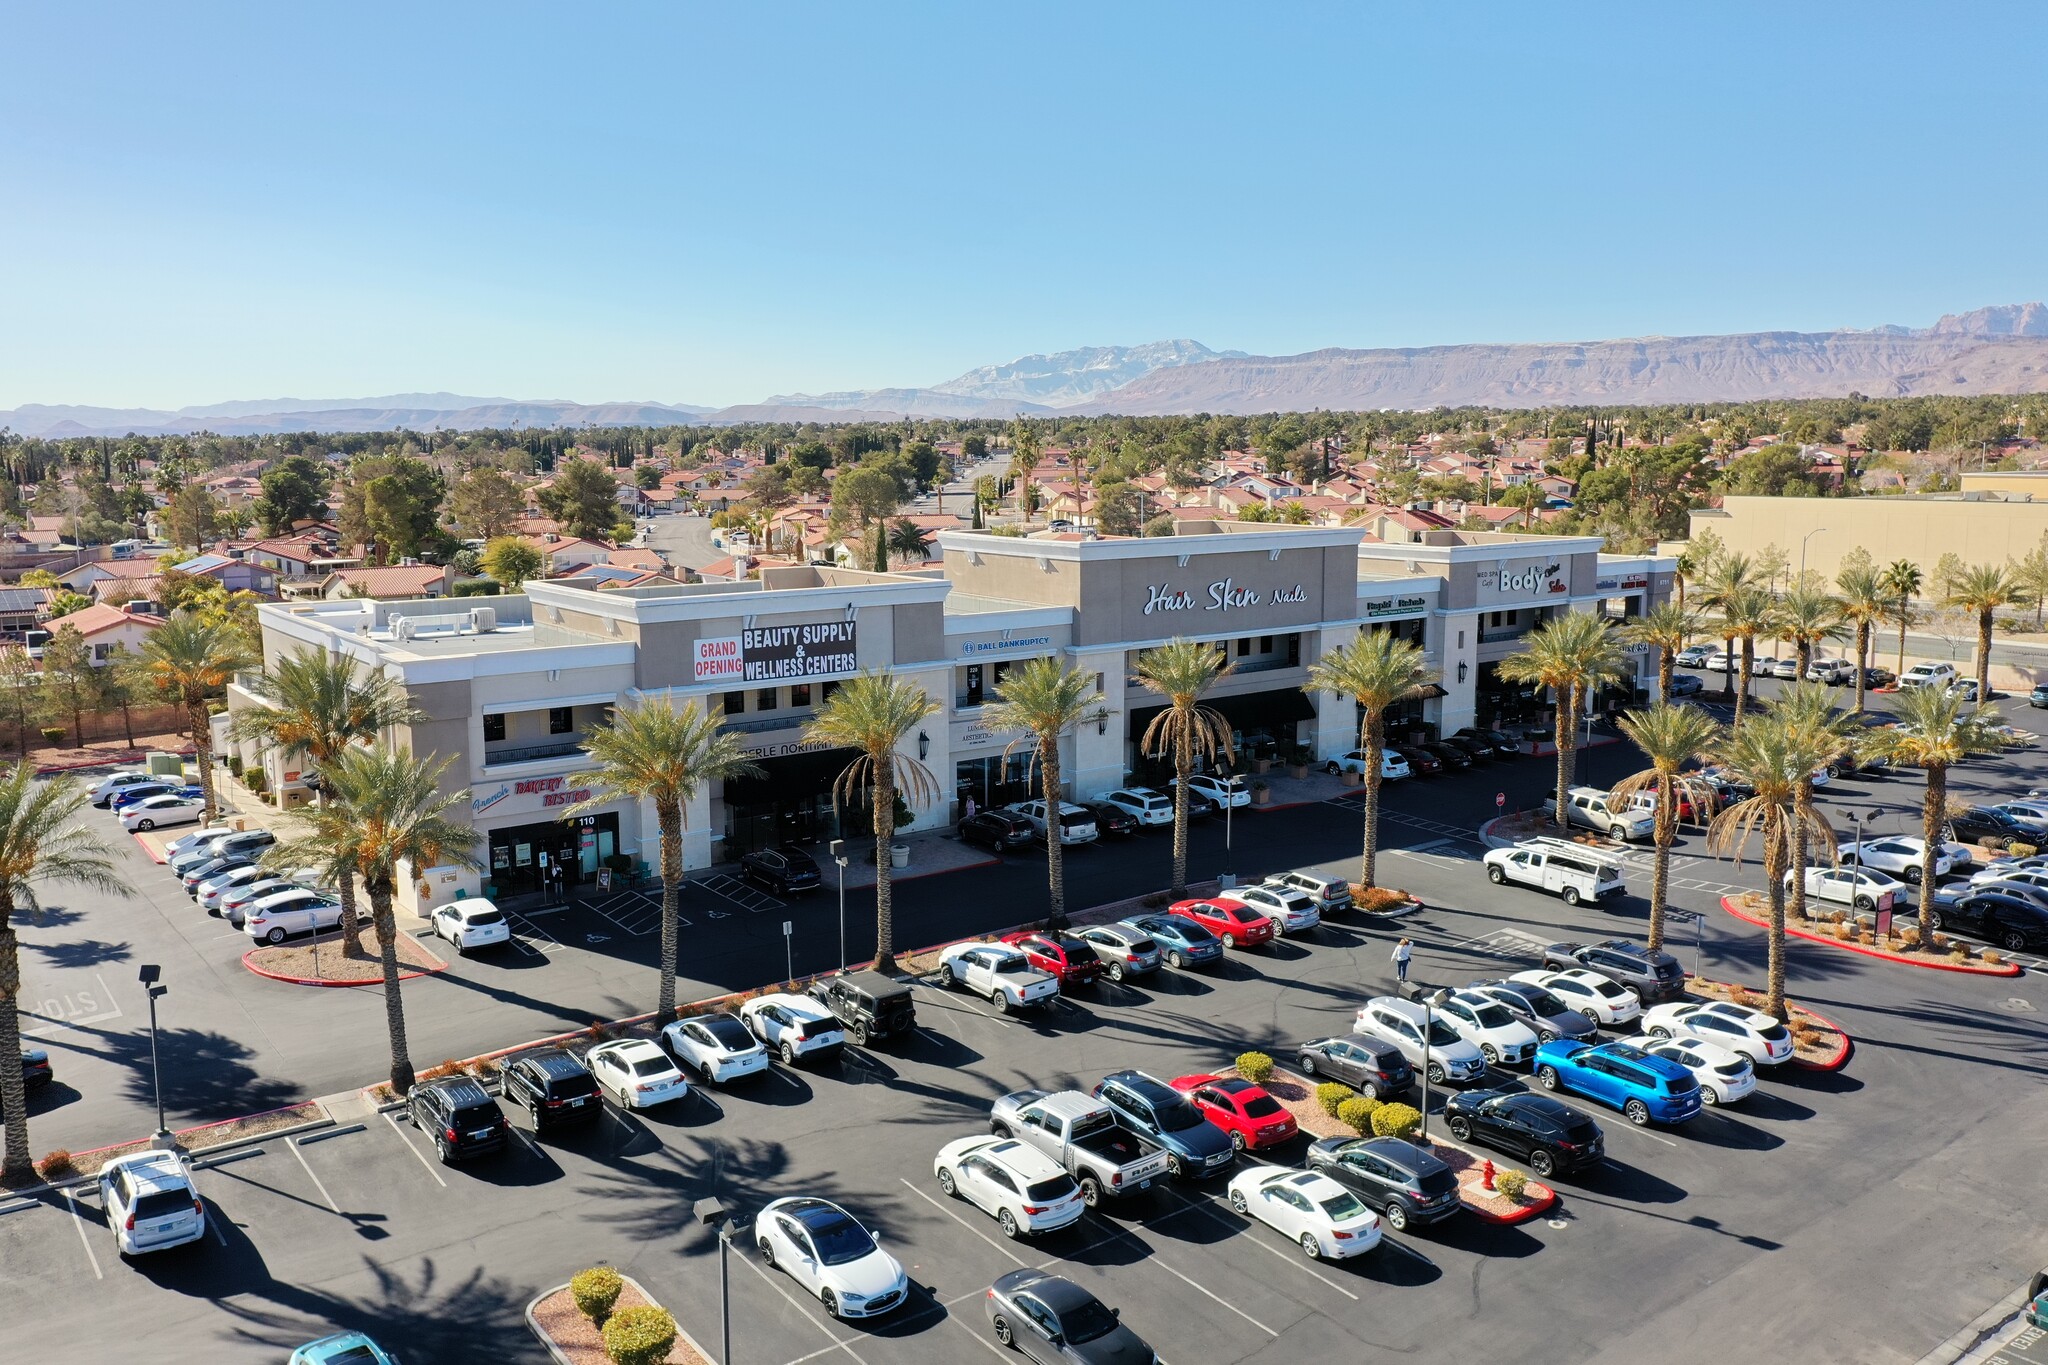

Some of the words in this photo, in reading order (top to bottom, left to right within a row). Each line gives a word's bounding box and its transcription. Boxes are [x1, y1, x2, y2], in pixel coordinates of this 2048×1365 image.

[1499, 567, 1545, 594] Body
[1144, 583, 1196, 615] Hair
[1205, 577, 1260, 612] Skin
[1269, 584, 1308, 606] Nails
[1398, 597, 1425, 607] Rehab
[744, 627, 799, 649] BEAUTY
[803, 623, 854, 644] SUPPLY
[978, 642, 997, 651] BALL
[998, 637, 1049, 649] BANKRUPTCY
[701, 640, 736, 658] GRAND
[795, 645, 806, 658] &
[696, 658, 742, 676] OPENING
[745, 658, 803, 680] WELLNESS
[806, 652, 855, 675] CENTERS
[472, 784, 509, 811] French
[515, 777, 563, 795] BAKERY
[543, 789, 591, 807] BISTRO
[579, 817, 595, 826] 110
[31, 991, 98, 1020] STOP
[1132, 1162, 1159, 1176] RAM
[2010, 1326, 2047, 1350] ERVED
